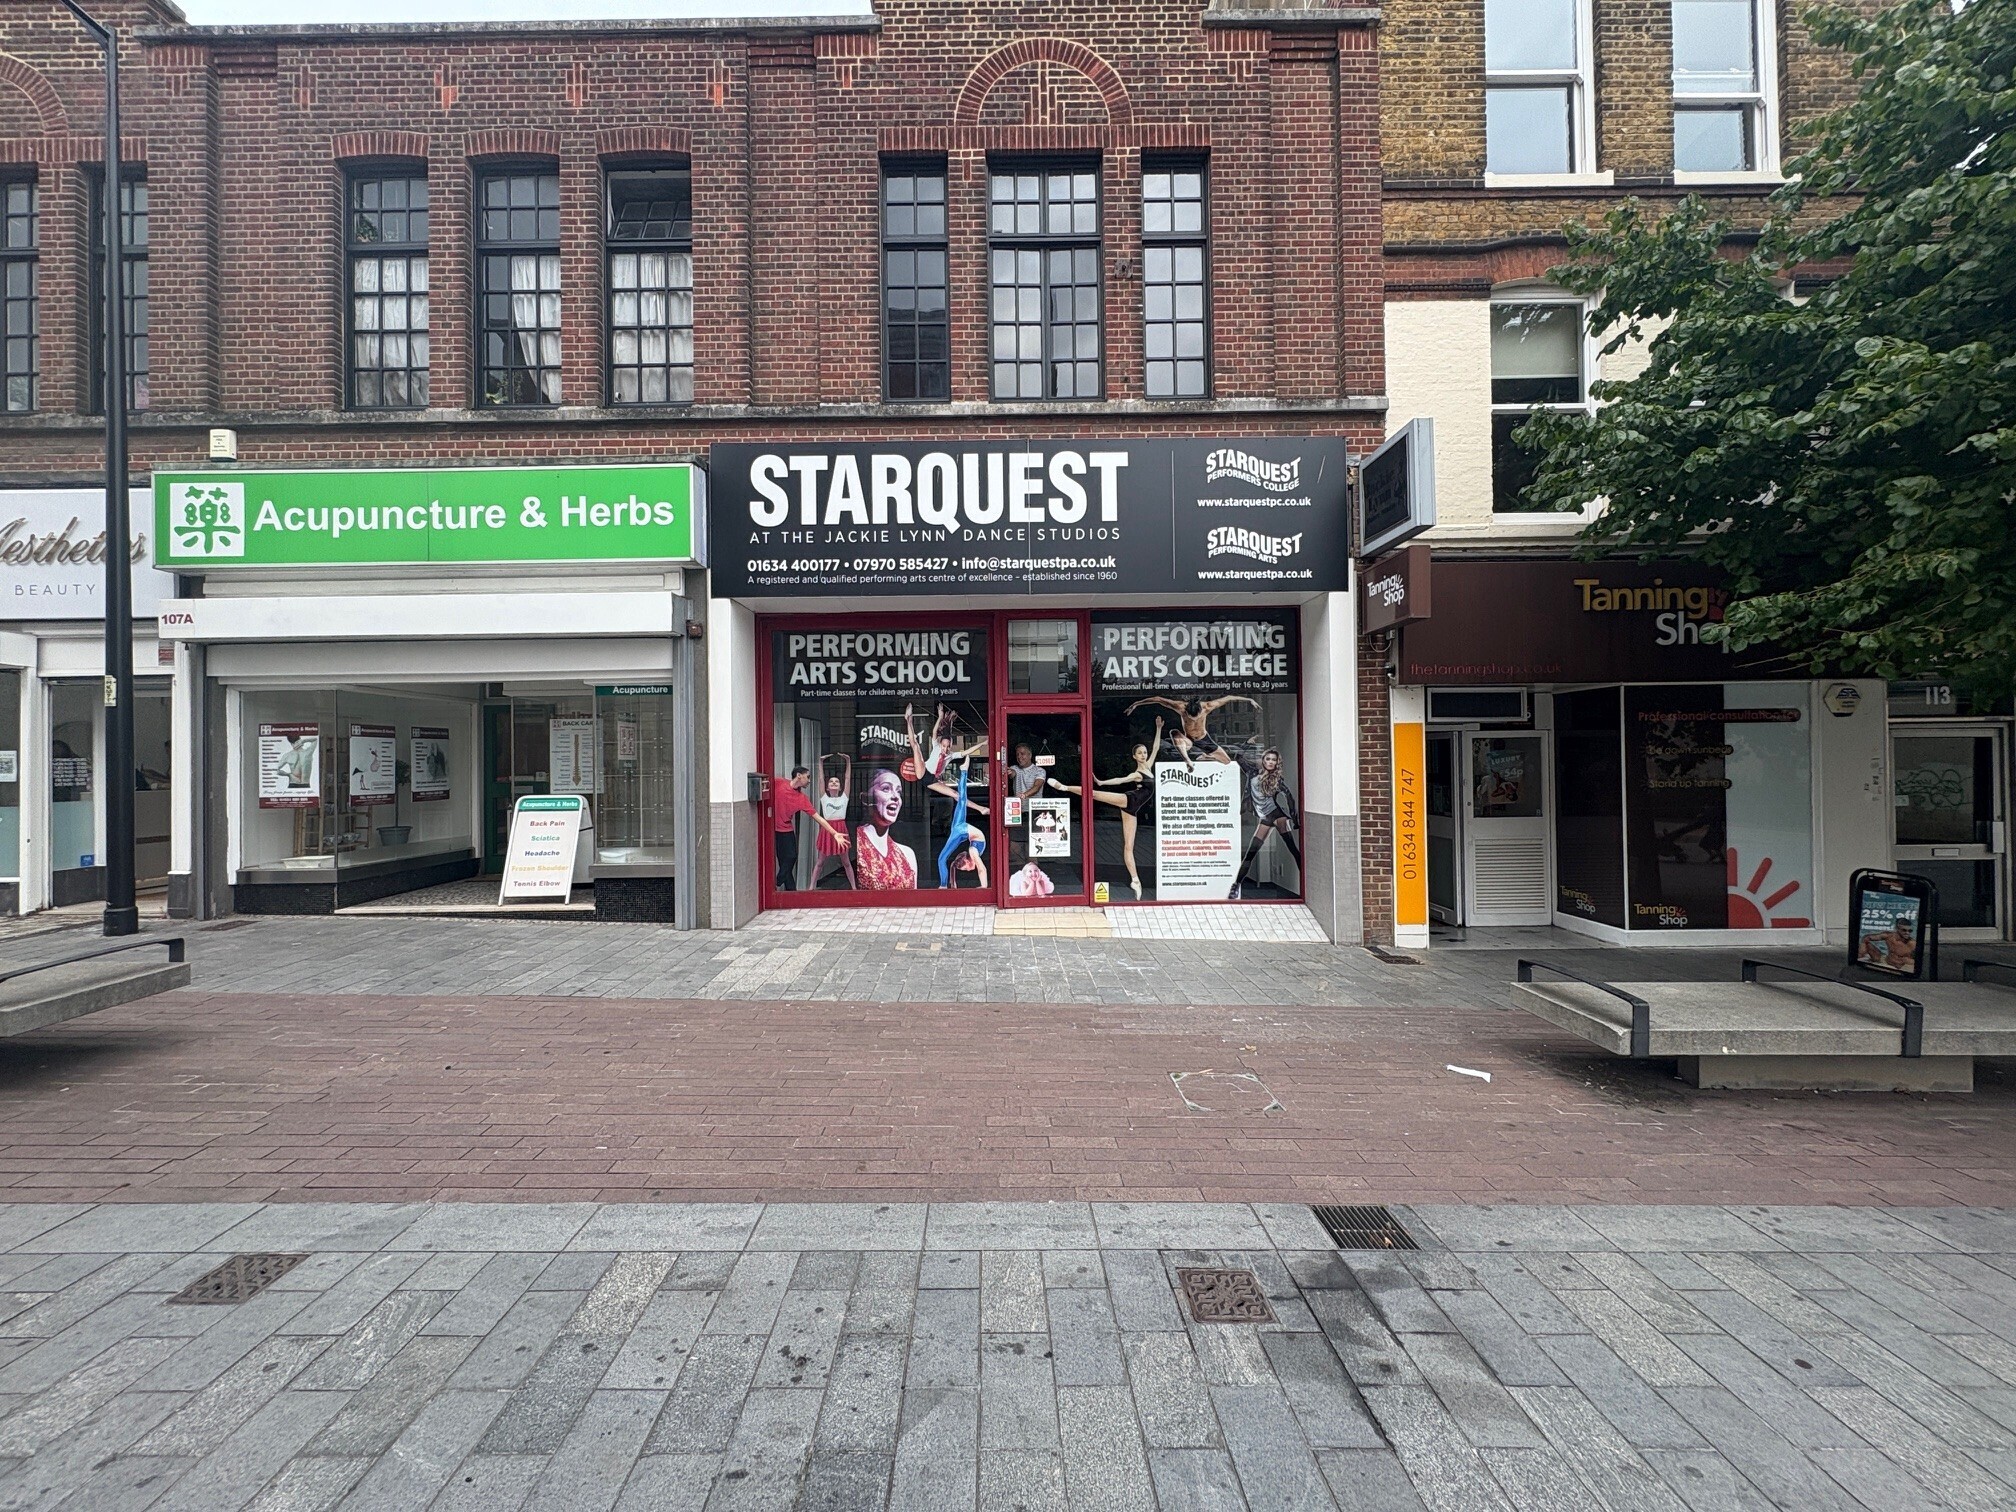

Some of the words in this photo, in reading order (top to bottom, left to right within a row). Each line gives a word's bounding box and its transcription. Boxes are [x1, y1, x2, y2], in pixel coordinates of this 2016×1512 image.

[1206, 449, 1301, 482] STARQUEST
[1207, 468, 1261, 487] PERFORMERS
[1262, 478, 1300, 492] COLLEGE
[750, 451, 1128, 534] STARQUEST
[1197, 497, 1311, 508] www.starquestpc.co.uk
[253, 498, 506, 538] Acupuncture
[519, 496, 548, 528] &
[561, 495, 675, 527] Herbs
[0, 517, 146, 565] esthets
[750, 531, 771, 544] AT
[781, 531, 814, 544] THE
[825, 530, 889, 543] JACKIE
[900, 529, 945, 542] LYNN
[964, 528, 1026, 541] DANCE
[1037, 528, 1120, 541] STUDIOS
[1207, 527, 1302, 557] STARQUEST
[747, 559, 788, 572] 01634
[791, 559, 840, 571] 400177
[853, 558, 896, 571] 07970
[899, 557, 948, 570] 585427
[961, 556, 1116, 572] info@starquestpa.co.uk
[1208, 546, 1257, 559] PERFORMING
[1258, 554, 1278, 564] ARTS
[747, 575, 754, 584] A
[757, 575, 800, 585] registered
[802, 575, 818, 584] and
[820, 574, 858, 585] qualified
[859, 574, 907, 584] performing
[910, 574, 926, 583] arts
[928, 573, 955, 582] centre
[957, 573, 967, 582] of
[969, 573, 1013, 582] excellence
[1022, 571, 1071, 581] established
[1073, 572, 1095, 581] since
[1097, 571, 1118, 580] 1960
[1197, 569, 1313, 580] www.starquestpa.co.uk
[15, 584, 96, 596] BEAUTY
[1367, 574, 1396, 598] Tanning
[1383, 588, 1405, 607] Shop
[1573, 578, 1708, 619] Tanning
[161, 614, 193, 624] 107A
[1103, 625, 1285, 651] PERFORMING
[1655, 611, 1731, 654] Sh
[789, 631, 970, 658] PERFORMING
[789, 661, 857, 685] ARTS
[864, 660, 971, 684] SCHOOL
[1103, 656, 1168, 679] ARTS
[1176, 654, 1288, 678] COLLEGE
[1410, 663, 1562, 676] thetanningshop.co.uk
[613, 686, 668, 695] Acupuncture
[800, 689, 831, 698] Part-time
[833, 689, 856, 697] classes
[857, 688, 867, 696] for
[868, 688, 896, 696] children
[897, 688, 914, 698] aged
[940, 688, 958, 696] years
[1102, 683, 1141, 691] Professional
[1142, 682, 1168, 690] full-time
[1171, 682, 1204, 690] vocational
[1205, 682, 1231, 691] training
[1231, 681, 1242, 689] for
[1243, 681, 1251, 689] 16
[1252, 681, 1260, 689] to
[1271, 682, 1289, 690] years
[1925, 686, 1951, 705] 113
[1638, 710, 1706, 721] Professional
[860, 725, 925, 747] STARQUET
[1036, 757, 1054, 765] CLOSED
[1491, 754, 1521, 765] LUXURY
[1160, 768, 1215, 788] STARQUEST
[1401, 768, 1415, 796] 747
[1649, 779, 1677, 789] Stand
[1680, 780, 1692, 789] up
[1402, 801, 1416, 828] 844
[1402, 833, 1417, 880] 01634
[1560, 886, 1588, 903] Tanning
[1576, 899, 1596, 915] Shop
[1634, 903, 1676, 916] Tanning
[1861, 909, 1893, 919] 25%
[1896, 910, 1918, 920] off
[1659, 914, 1688, 927] Shop
